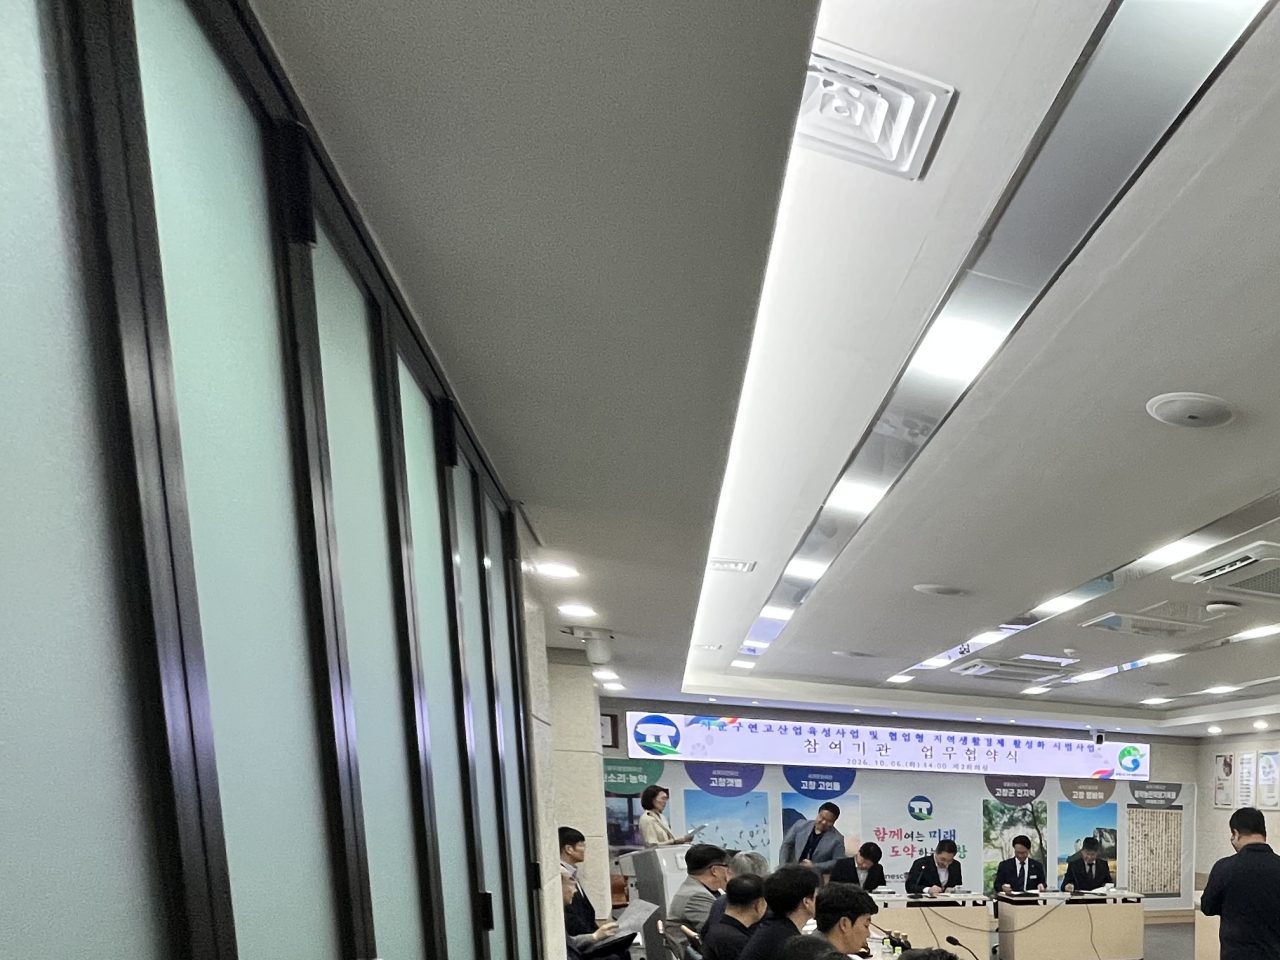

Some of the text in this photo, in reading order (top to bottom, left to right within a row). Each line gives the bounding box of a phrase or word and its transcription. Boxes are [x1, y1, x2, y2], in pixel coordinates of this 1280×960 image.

[804, 738, 1018, 764] 참여기관 업무협약식
[869, 730, 878, 740] 및
[889, 731, 924, 743] 협업형
[1053, 741, 1095, 753] 시범사업
[604, 773, 648, 785] 소리·농악
[873, 827, 956, 843] 함께여는 미래
